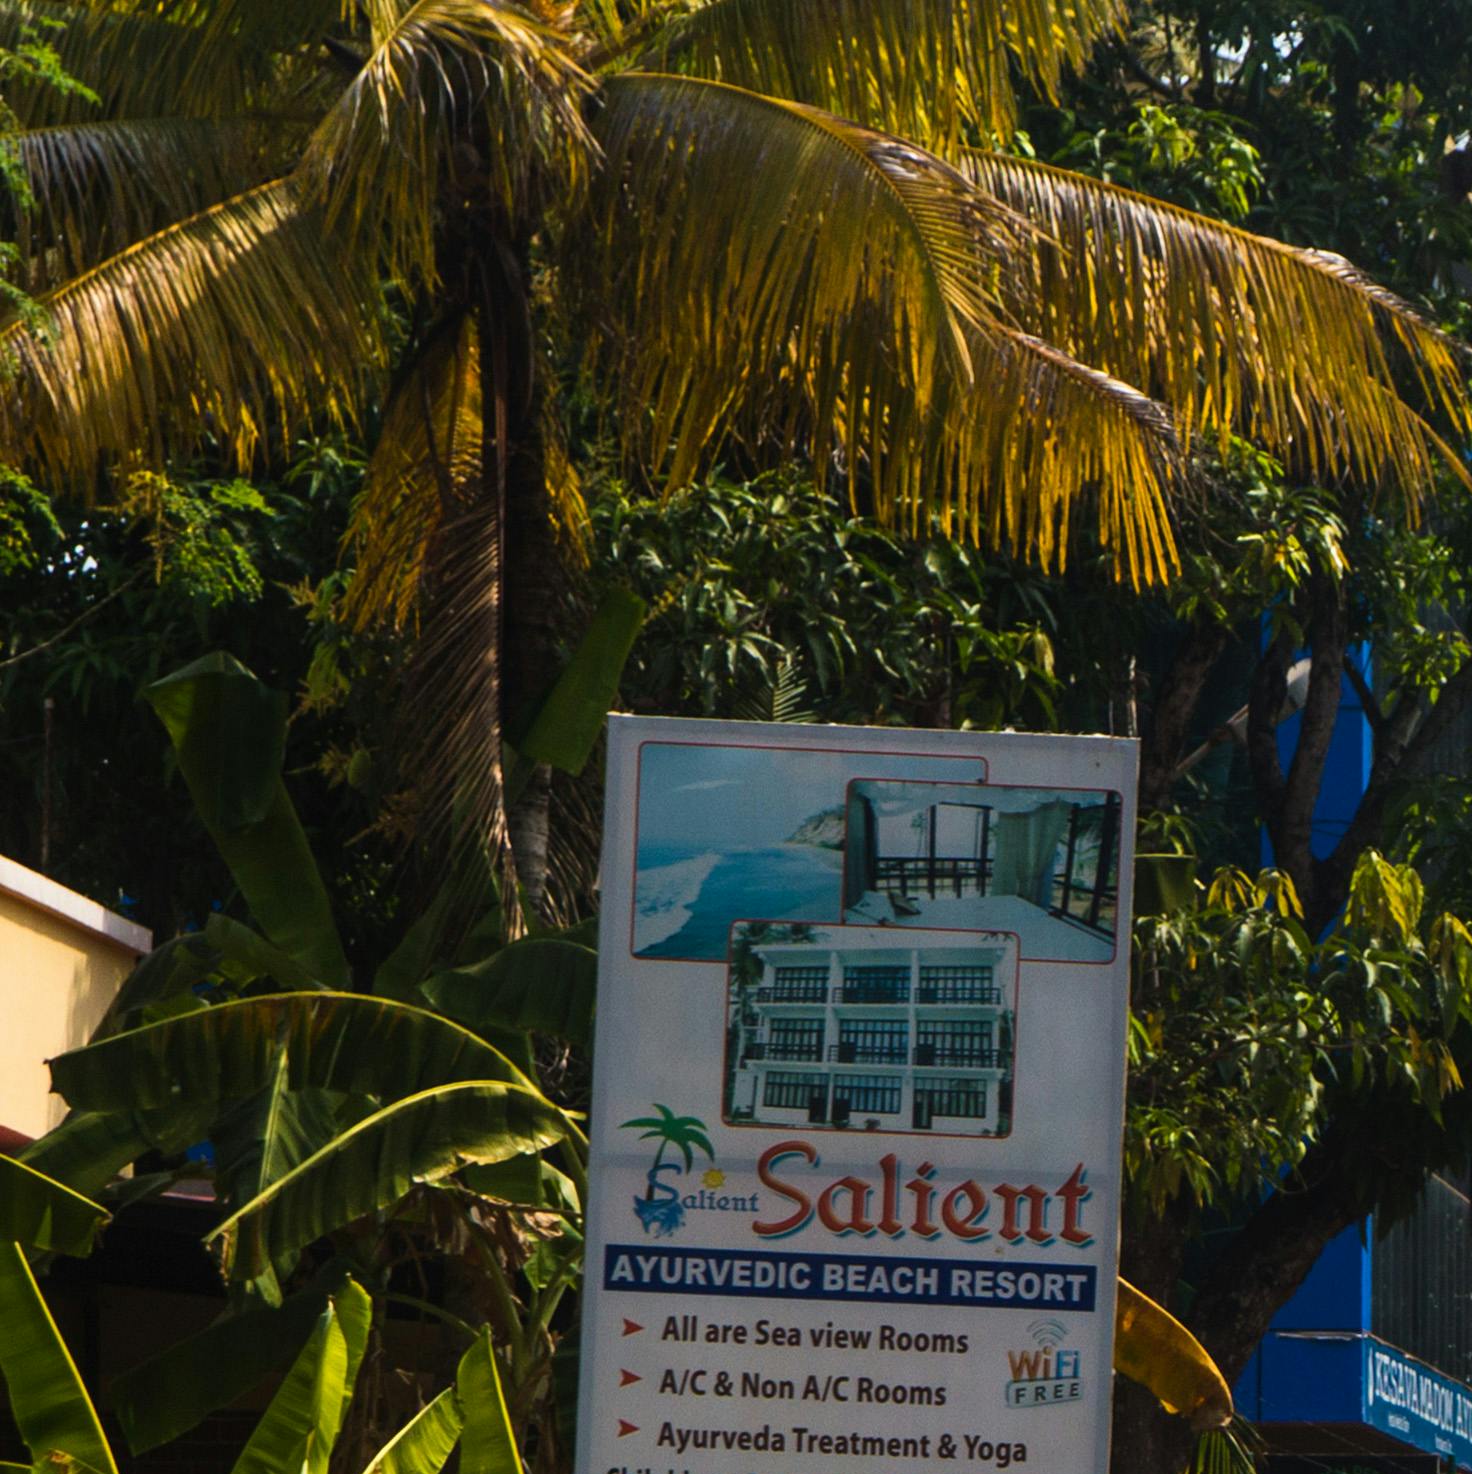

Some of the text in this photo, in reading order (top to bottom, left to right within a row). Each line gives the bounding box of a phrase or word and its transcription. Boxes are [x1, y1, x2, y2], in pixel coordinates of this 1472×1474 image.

[647, 1163, 759, 1213] Salient
[752, 1140, 1094, 1247] Salient
[610, 1254, 1088, 1302] AYURVEDIC BEACH RESORT
[661, 1315, 969, 1354] All are Sea view Rooms
[659, 1369, 947, 1405] A/C & Non A/C Rooms
[1007, 1346, 1081, 1382] WiFi
[1374, 1351, 1418, 1415] KESAVA
[1014, 1383, 1080, 1404] FREE
[656, 1422, 1027, 1468] Ayurveda Treatment & Yoga
